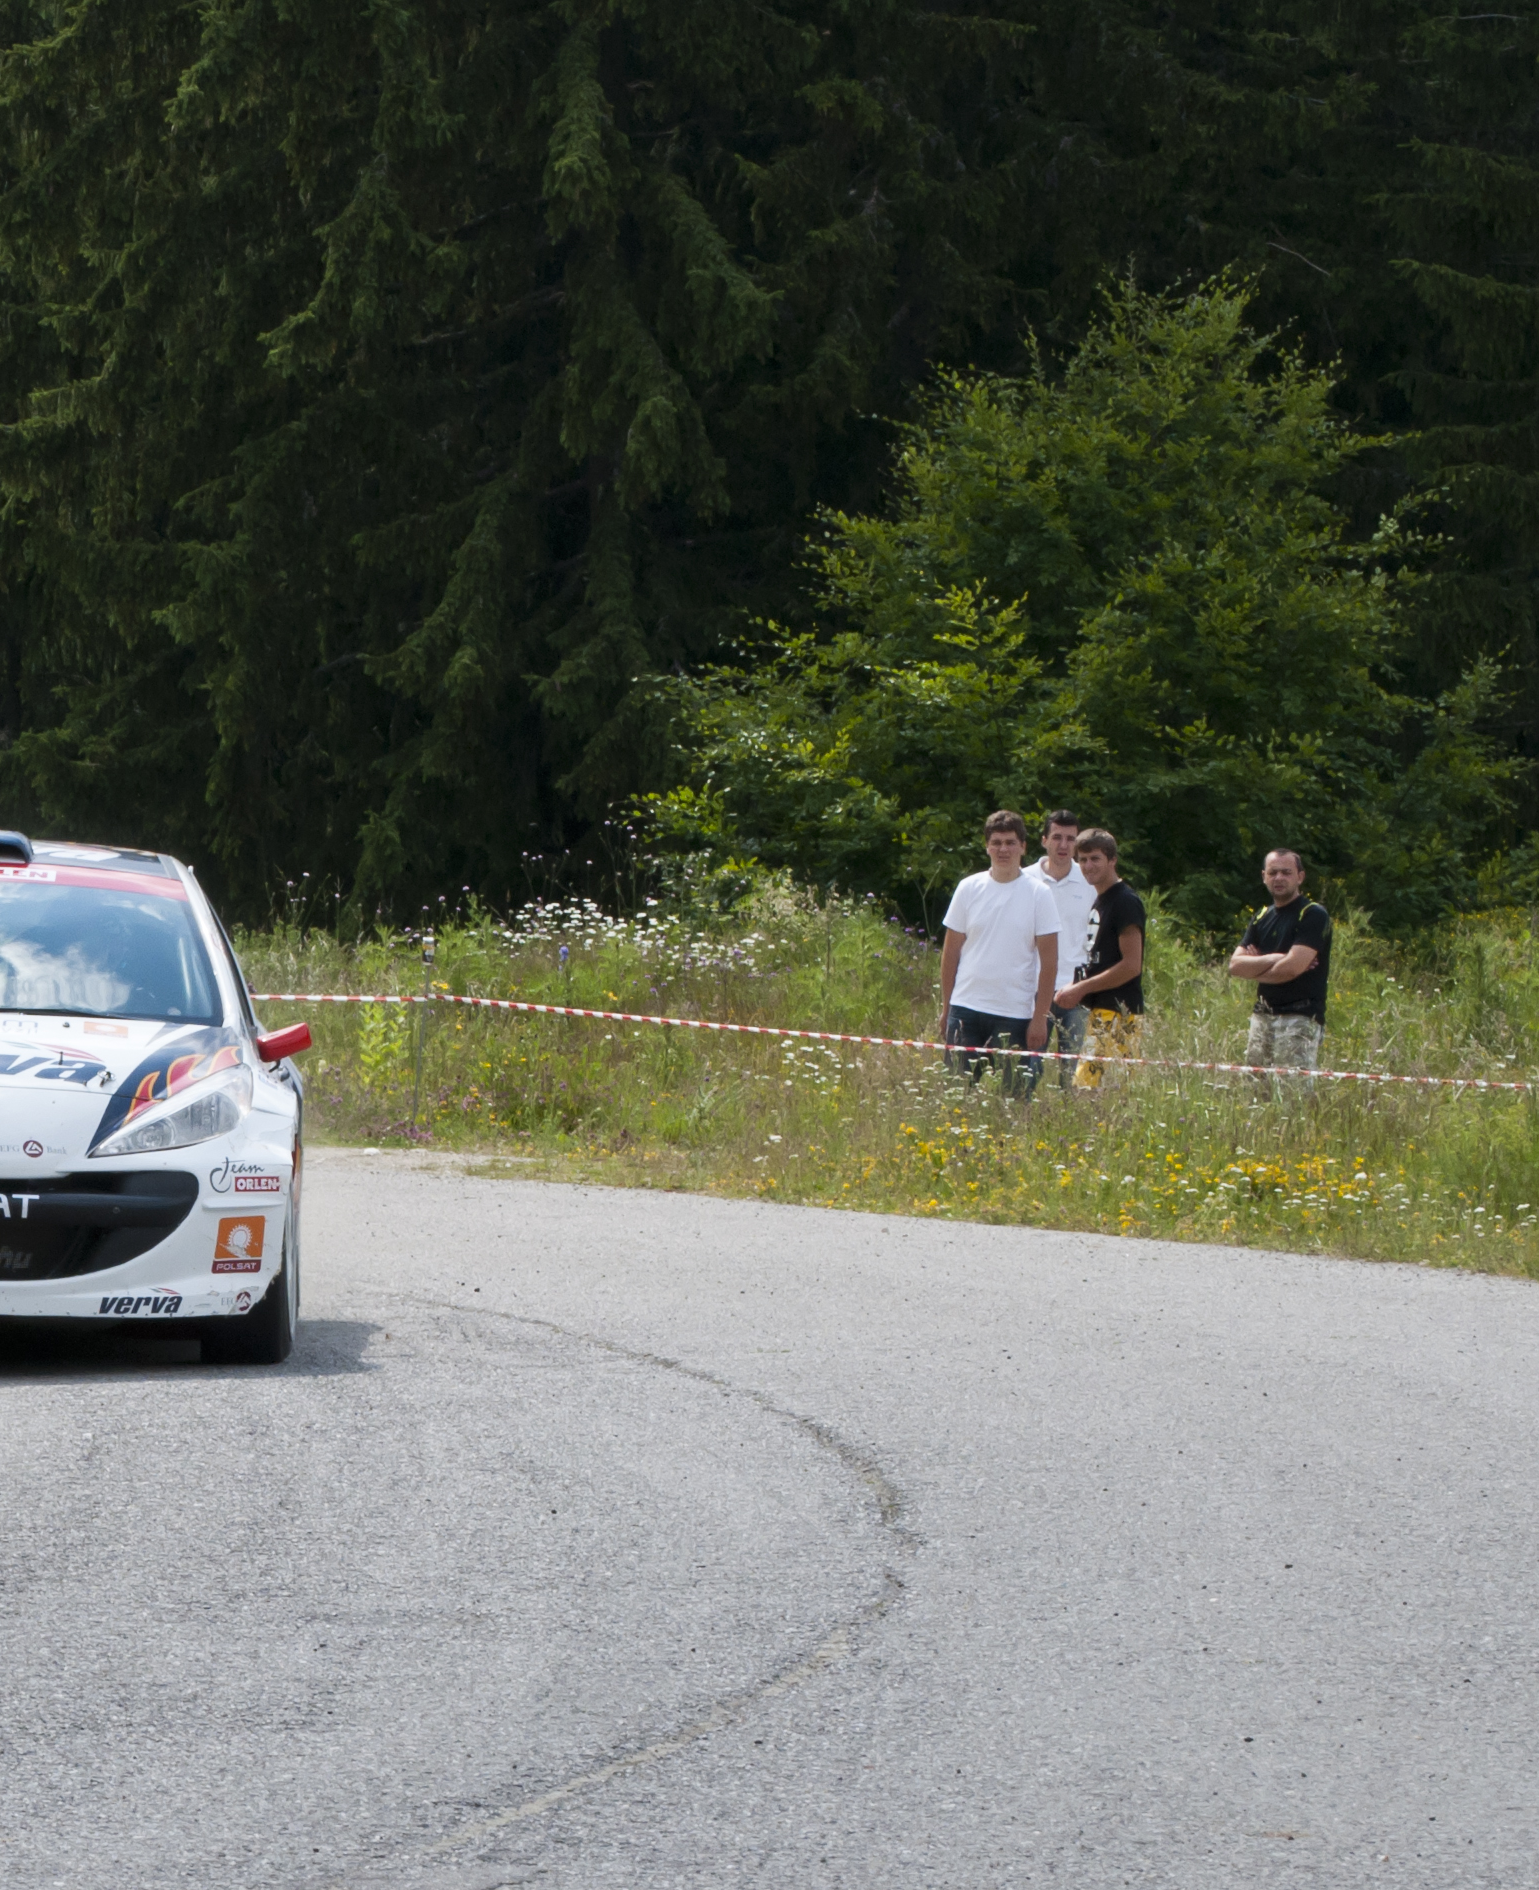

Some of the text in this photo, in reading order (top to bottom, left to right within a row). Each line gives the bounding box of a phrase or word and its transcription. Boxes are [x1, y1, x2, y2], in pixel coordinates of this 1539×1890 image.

[236, 1177, 277, 1190] ORLEN
[215, 1261, 257, 1272] POLSAT
[98, 1295, 183, 1314] verva
